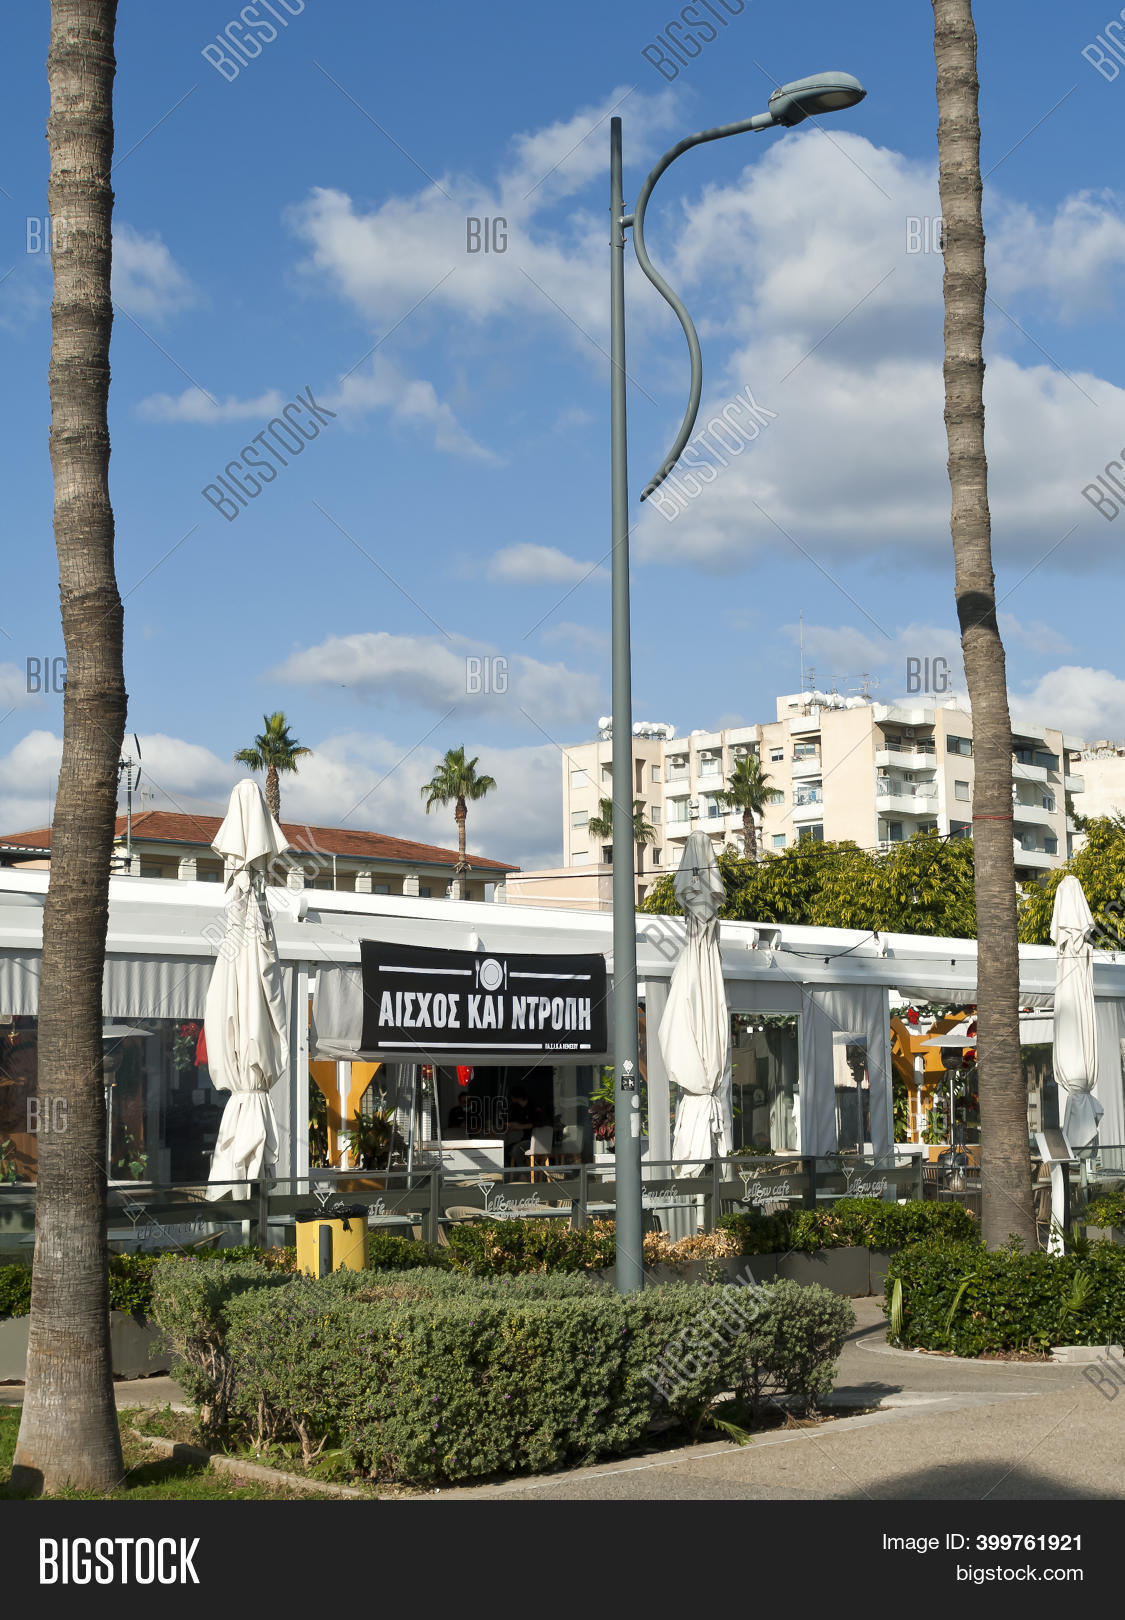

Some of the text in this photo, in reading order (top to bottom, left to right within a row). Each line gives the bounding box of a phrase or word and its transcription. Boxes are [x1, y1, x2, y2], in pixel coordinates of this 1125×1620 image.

[378, 991, 591, 1031] ΑΙΣΧΟΣ ΚΑΙ ΝΤΡΟΠΗ
[364, 1197, 386, 1217] afe
